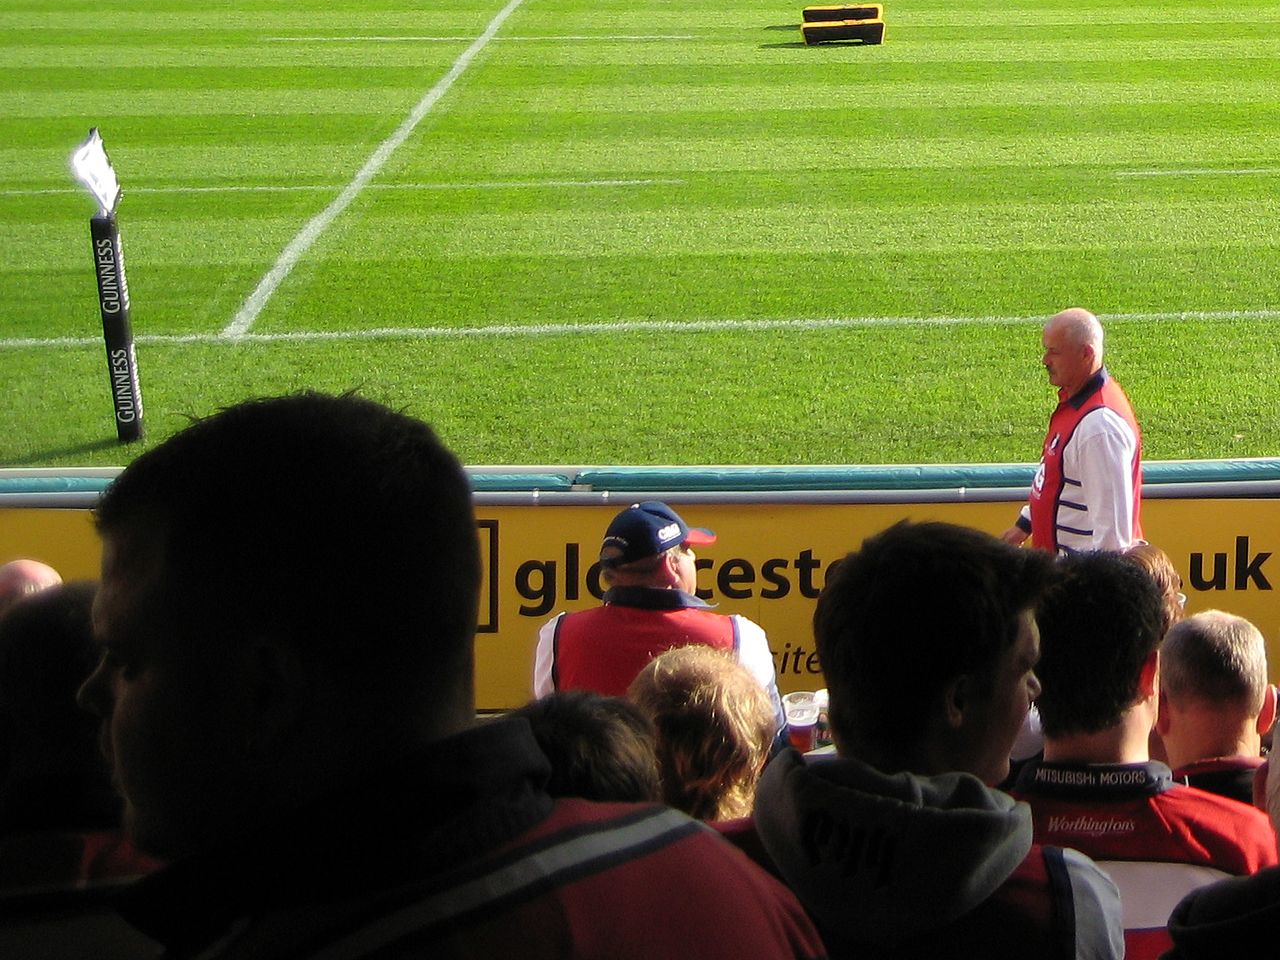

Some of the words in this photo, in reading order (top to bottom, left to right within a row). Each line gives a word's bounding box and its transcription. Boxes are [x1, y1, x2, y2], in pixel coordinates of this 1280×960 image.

[96, 238, 120, 314] GUINNESS
[111, 348, 135, 423] GUINNESS
[1036, 767, 1096, 785] MITSUBISHI
[1100, 770, 1146, 785] MOTORS
